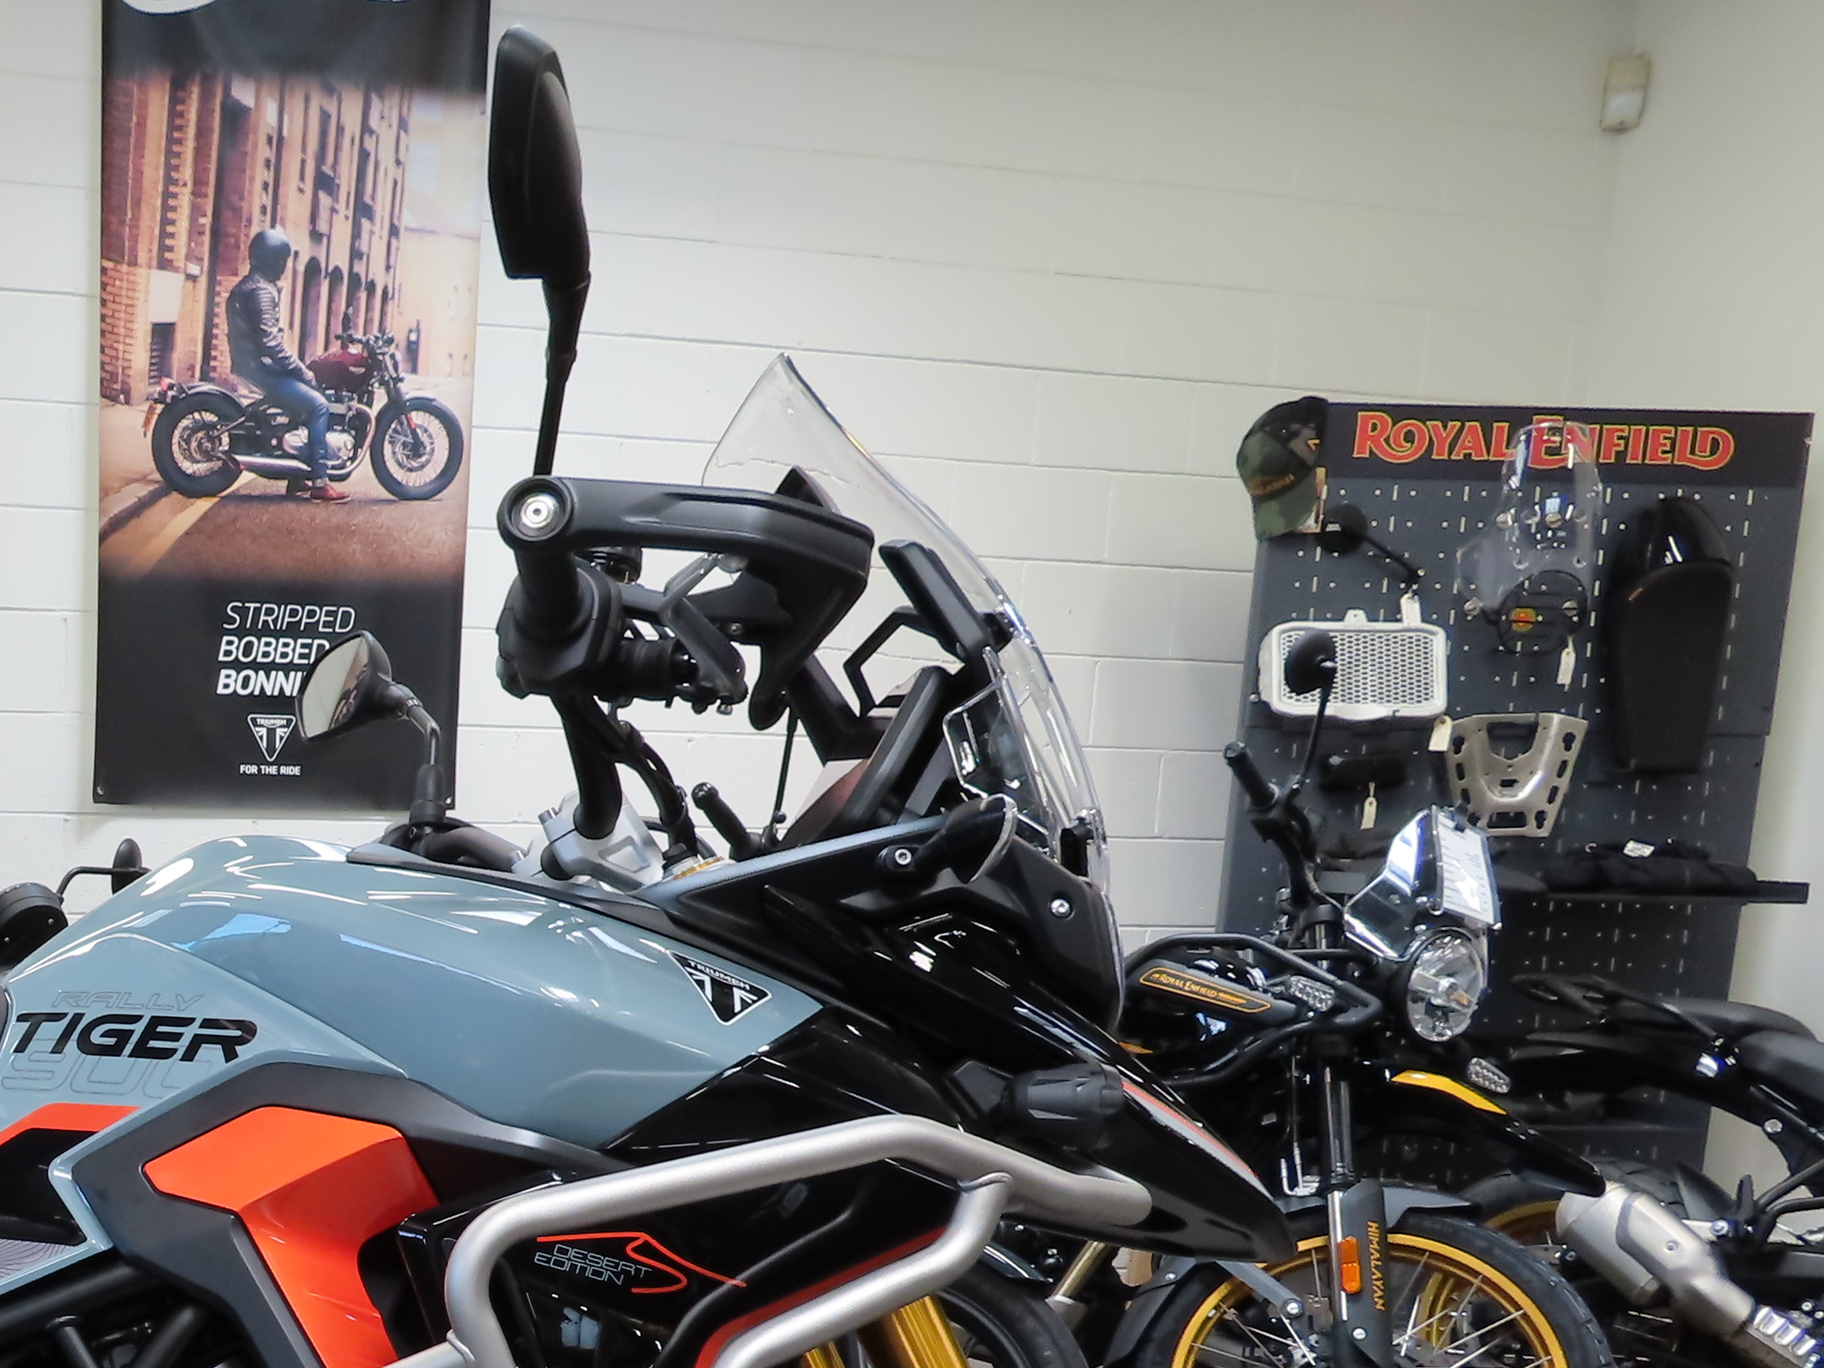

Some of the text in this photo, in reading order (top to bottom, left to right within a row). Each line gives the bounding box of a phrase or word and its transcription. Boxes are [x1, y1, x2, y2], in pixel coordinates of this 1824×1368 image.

[1352, 411, 1735, 470] ROYAL ENFIELD
[222, 601, 356, 633] STRIPPED
[216, 669, 307, 697] BONNI
[256, 718, 287, 729] TRIUMPH
[239, 764, 301, 776] FOR THE RIDE
[687, 959, 751, 991] TRIUMPH
[1159, 973, 1218, 998] ROYAL ENFIELD
[51, 991, 206, 1012] RALLY
[12, 1011, 258, 1064] TIGER
[534, 1252, 624, 1285] EDITION
[553, 1244, 652, 1278] DESERT
[1366, 1220, 1385, 1311] HIMALAYAN
